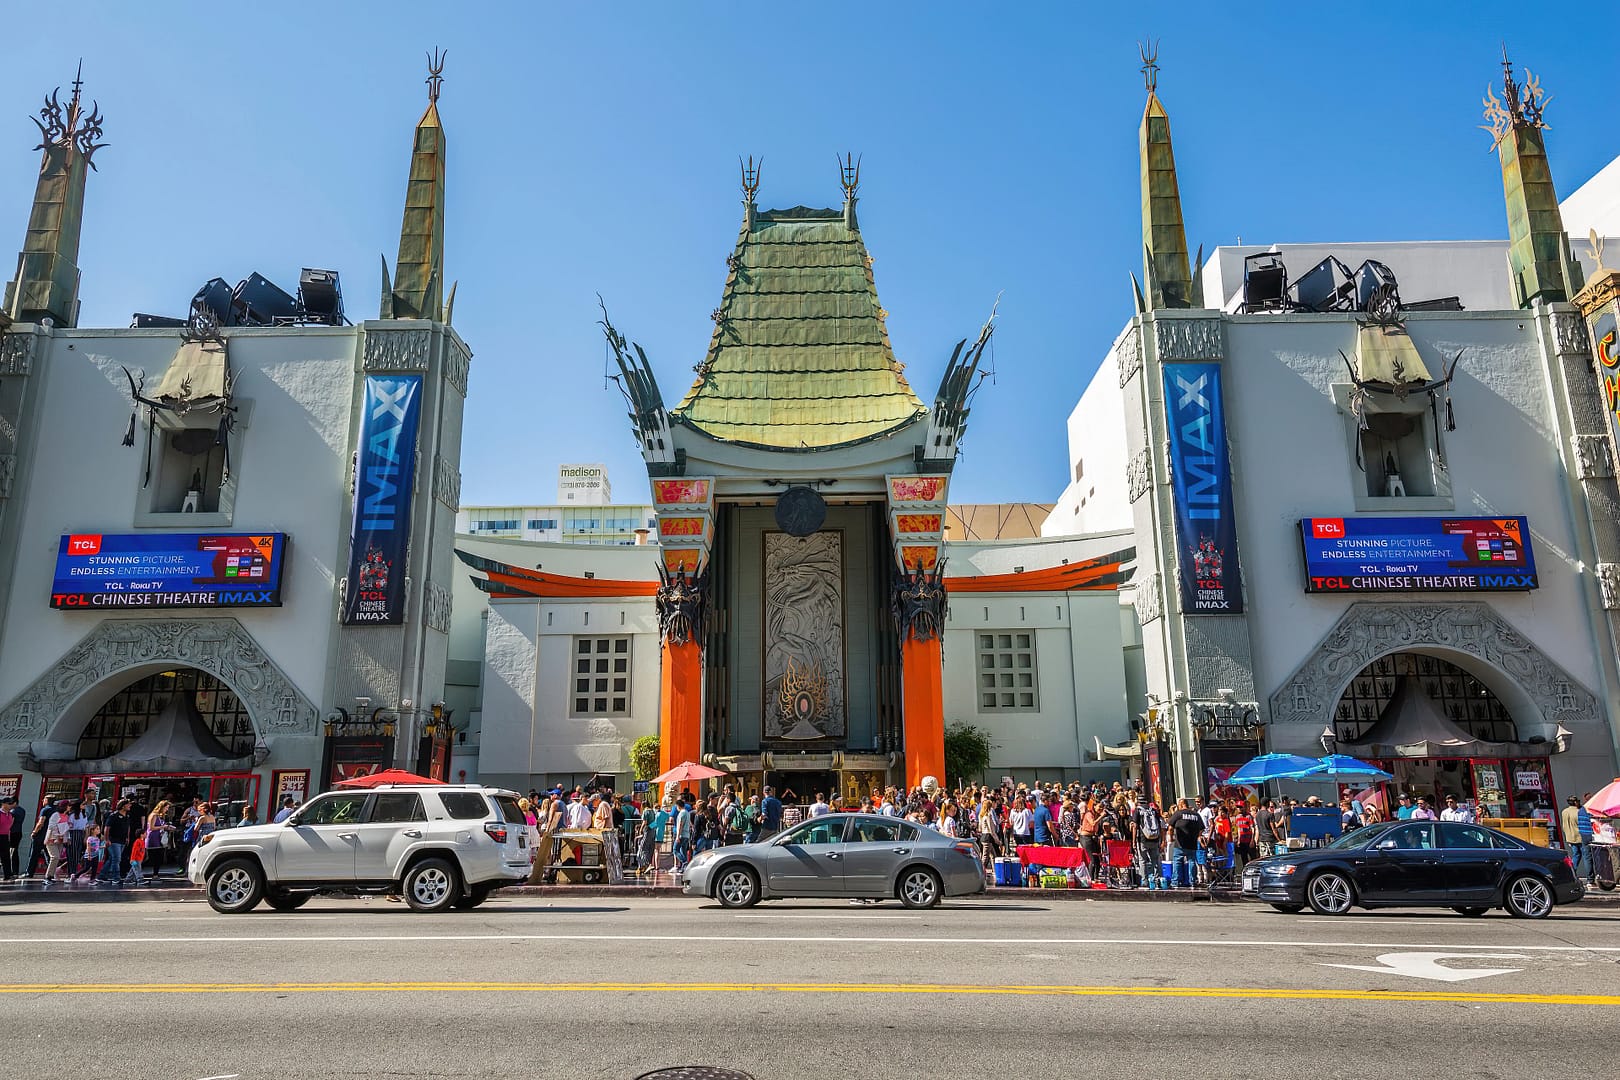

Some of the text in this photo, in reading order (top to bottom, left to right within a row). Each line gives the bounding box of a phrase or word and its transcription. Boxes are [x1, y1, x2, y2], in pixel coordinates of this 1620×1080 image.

[1176, 373, 1221, 520] IMAX
[361, 383, 408, 530] IMAX
[561, 466, 601, 477] madison
[1317, 523, 1341, 533] TCL
[1504, 521, 1517, 530] 4K
[73, 540, 97, 549] TCL
[258, 537, 273, 546] 4K
[1336, 538, 1436, 548] STUNNING PICTURE.
[1322, 549, 1454, 559] ENDLESS ENTERTAINMENT.
[88, 554, 187, 565] STUNNING PICTURE.
[71, 565, 201, 576] ENDLESS ENTERTAINMENT.
[1359, 565, 1418, 573] TCL Roku TV
[104, 581, 163, 590] TCL Roku TV
[1197, 580, 1224, 589] TCL
[1312, 575, 1535, 589] TCL CHINESE THEATRE IMAX
[53, 591, 273, 606] TCL CHINESE THEATRE IMAX
[360, 591, 386, 600] TCL
[1195, 601, 1230, 609] IMAX
[356, 612, 390, 621] IMAX
[281, 783, 288, 791] 3
